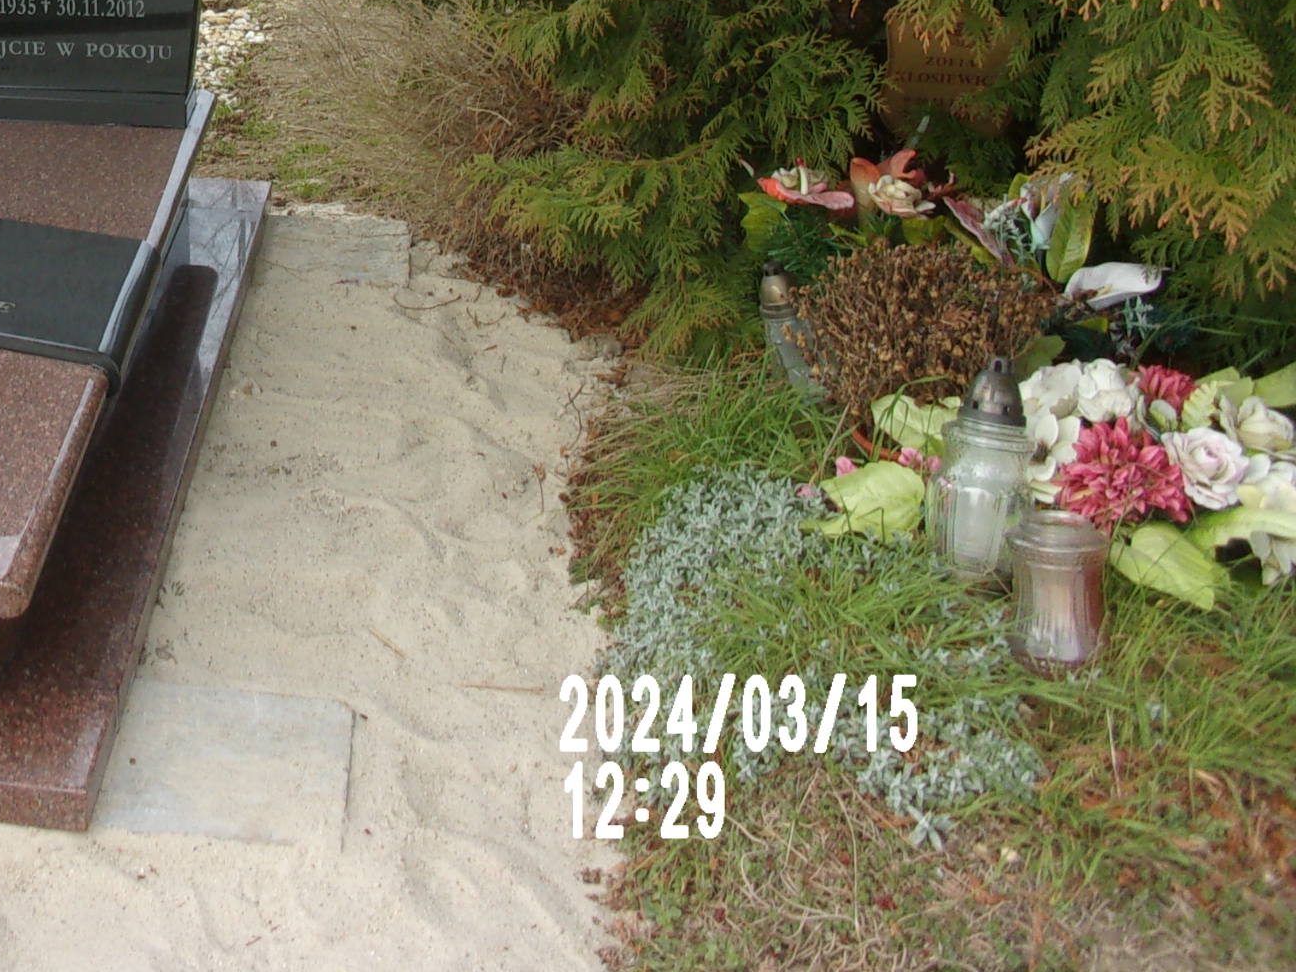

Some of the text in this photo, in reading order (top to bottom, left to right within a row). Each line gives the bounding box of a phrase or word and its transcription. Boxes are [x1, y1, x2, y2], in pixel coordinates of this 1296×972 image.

[56, 0, 145, 18] 30.11.2012
[57, 41, 74, 57] W
[86, 42, 173, 61] POKOJU
